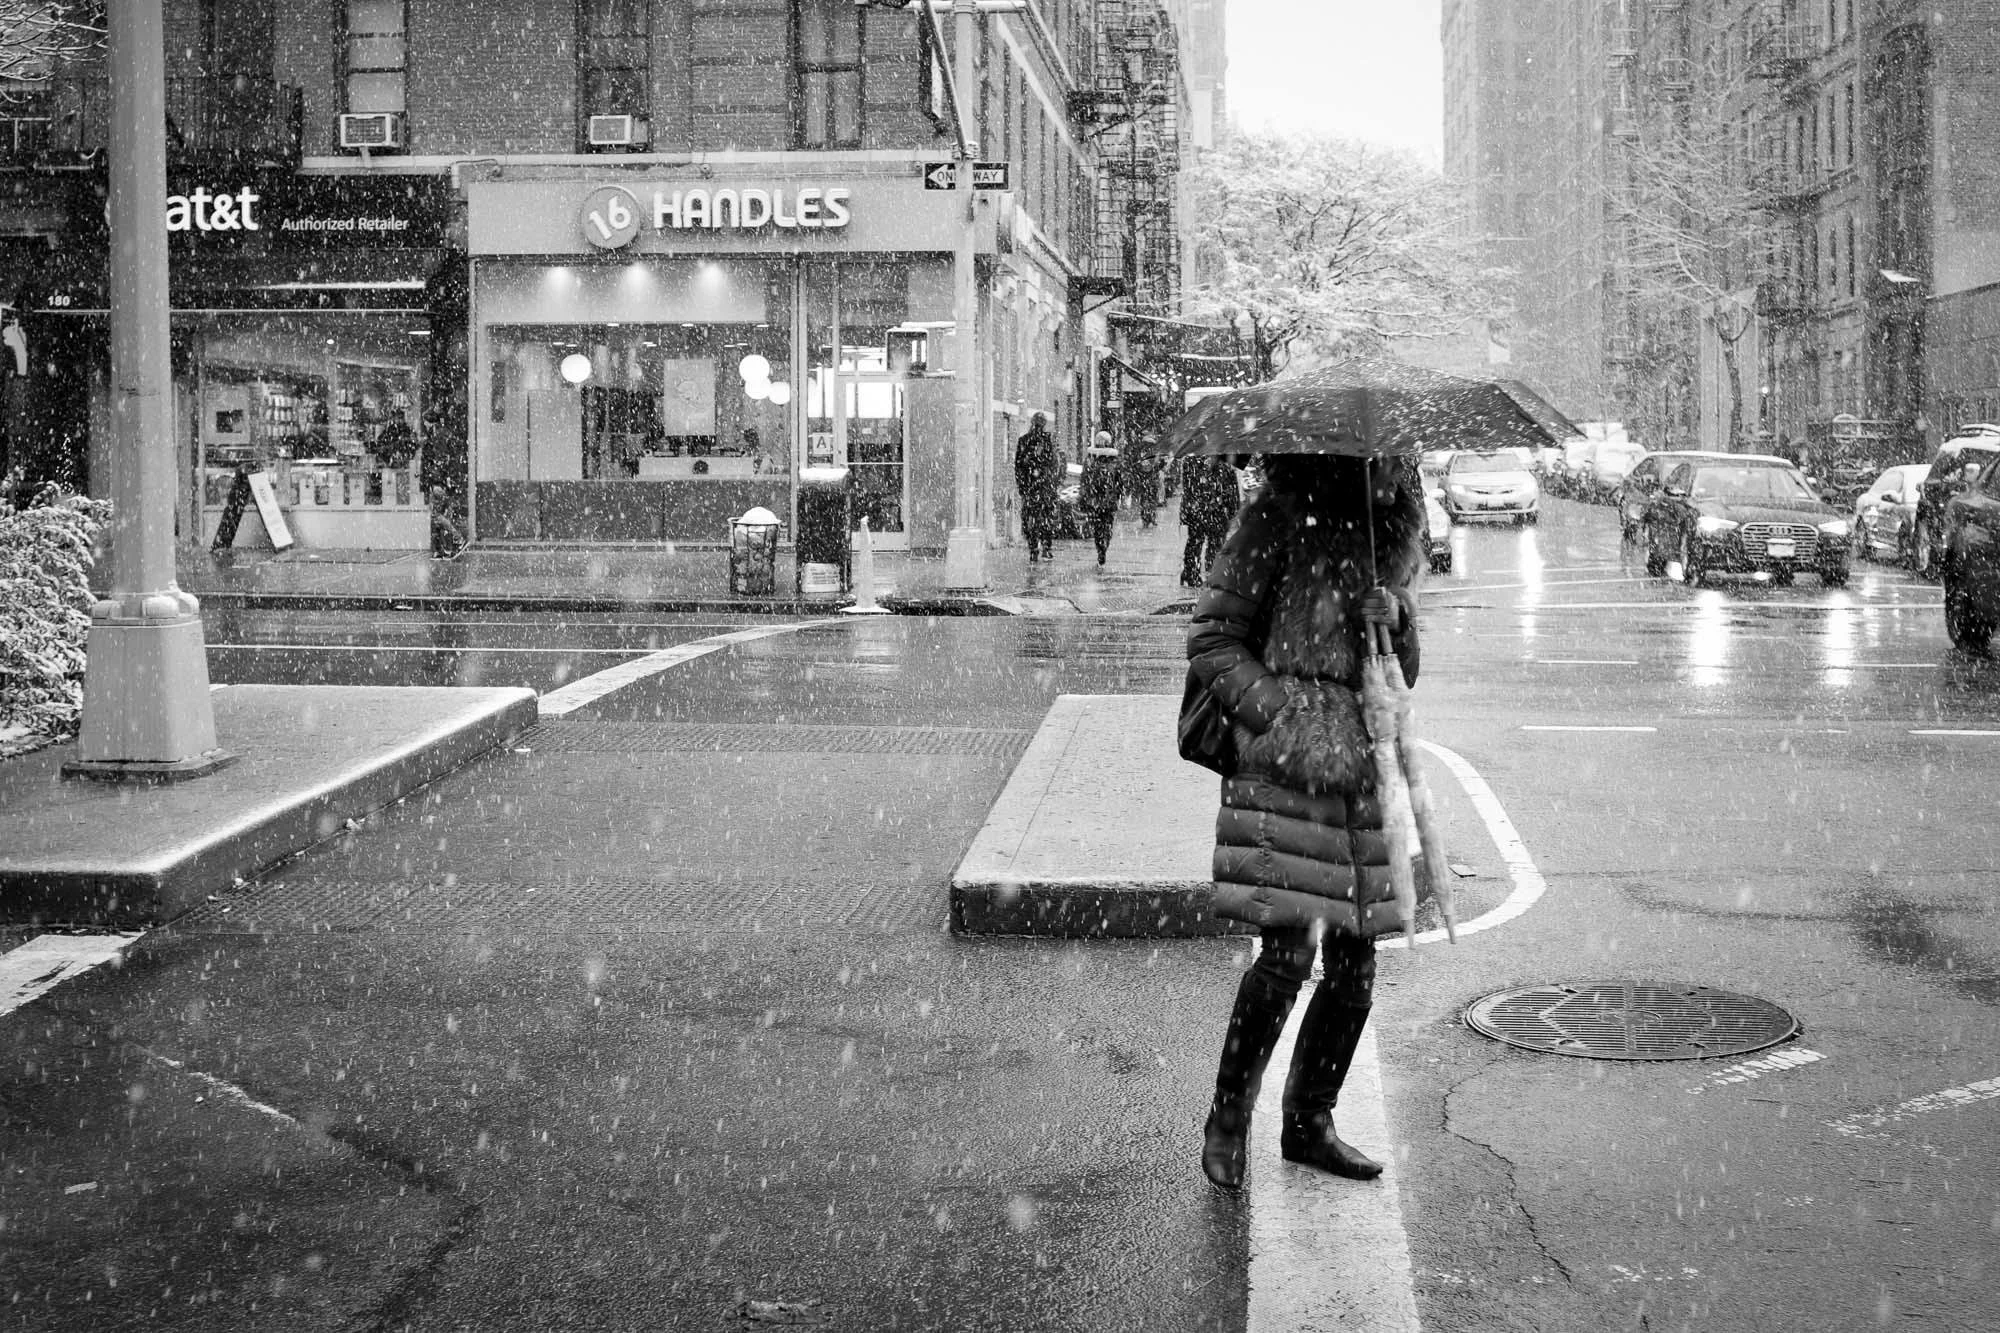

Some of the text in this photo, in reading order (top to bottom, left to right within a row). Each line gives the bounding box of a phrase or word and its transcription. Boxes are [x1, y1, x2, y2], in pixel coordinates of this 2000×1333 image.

[973, 171, 998, 182] WAY
[166, 186, 408, 231] at&t Authorized Retailer
[589, 188, 849, 240] 16 HANDLES
[48, 295, 70, 306] 180
[816, 436, 827, 449] A
